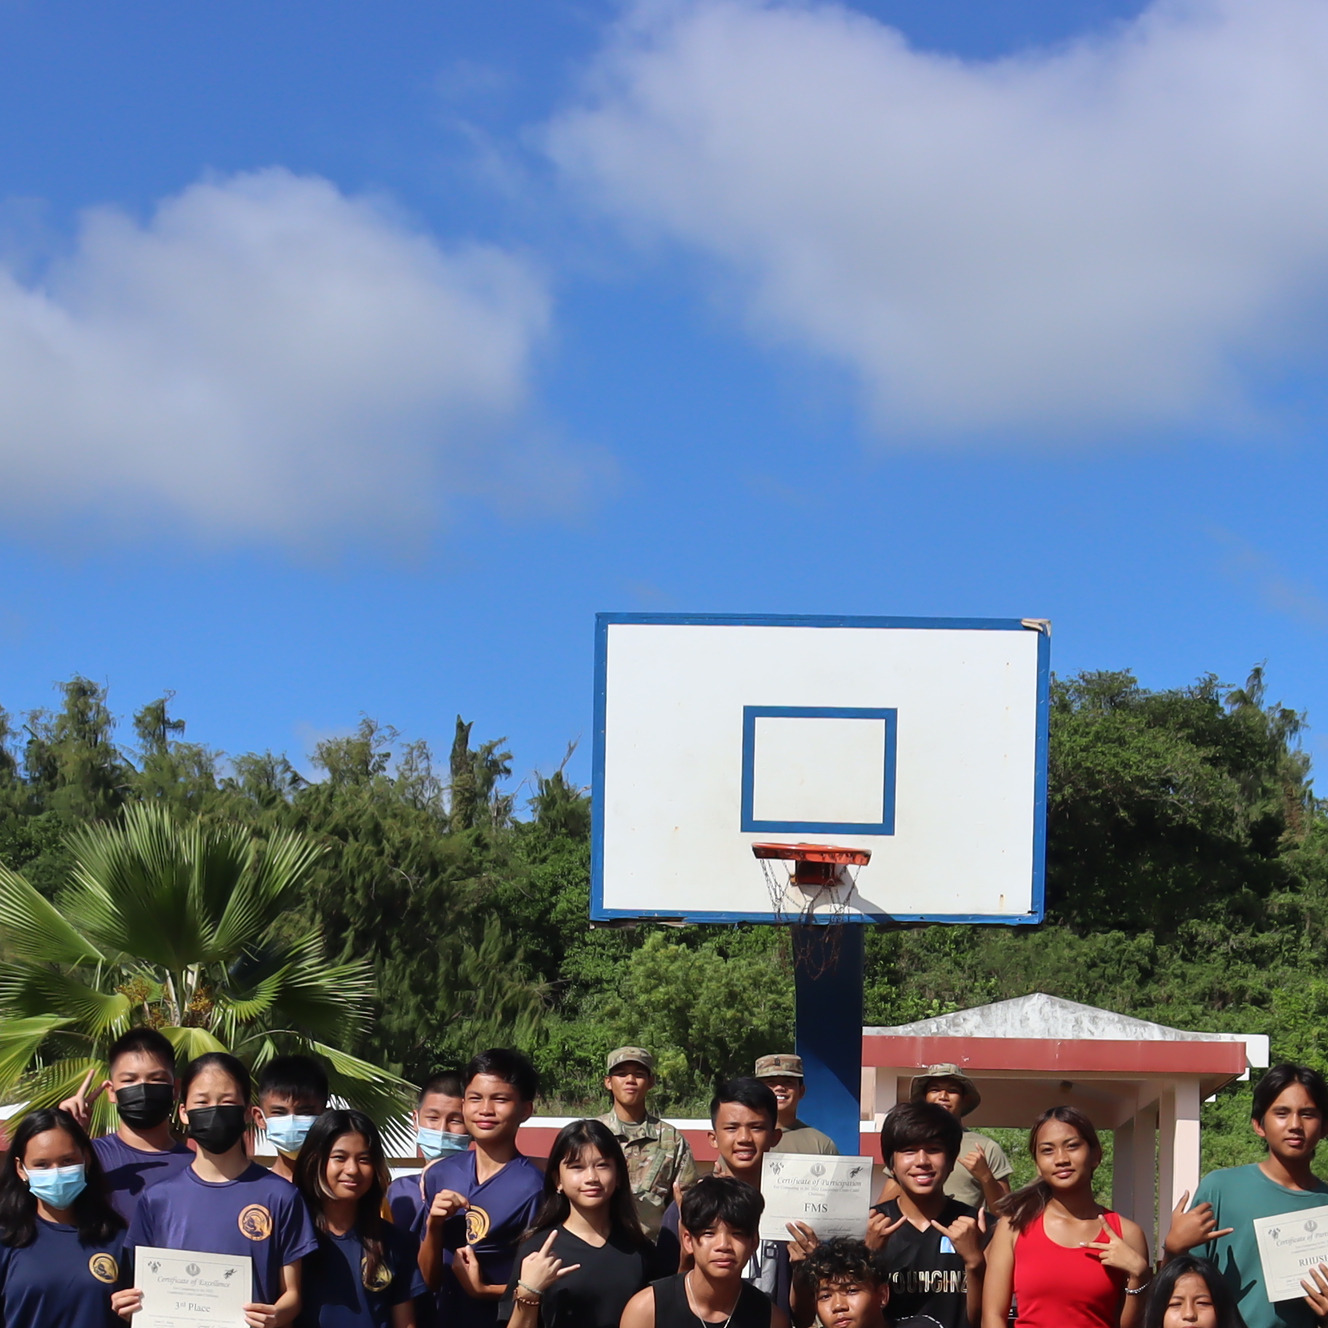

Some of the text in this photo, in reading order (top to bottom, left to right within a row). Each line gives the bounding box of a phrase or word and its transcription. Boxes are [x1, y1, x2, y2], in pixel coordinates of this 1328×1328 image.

[777, 1177, 811, 1187] Certificate
[812, 1178, 820, 1188] of
[804, 1202, 828, 1213] FMS
[157, 1275, 230, 1288] Certificate of Excellence
[188, 1302, 211, 1313] Place
